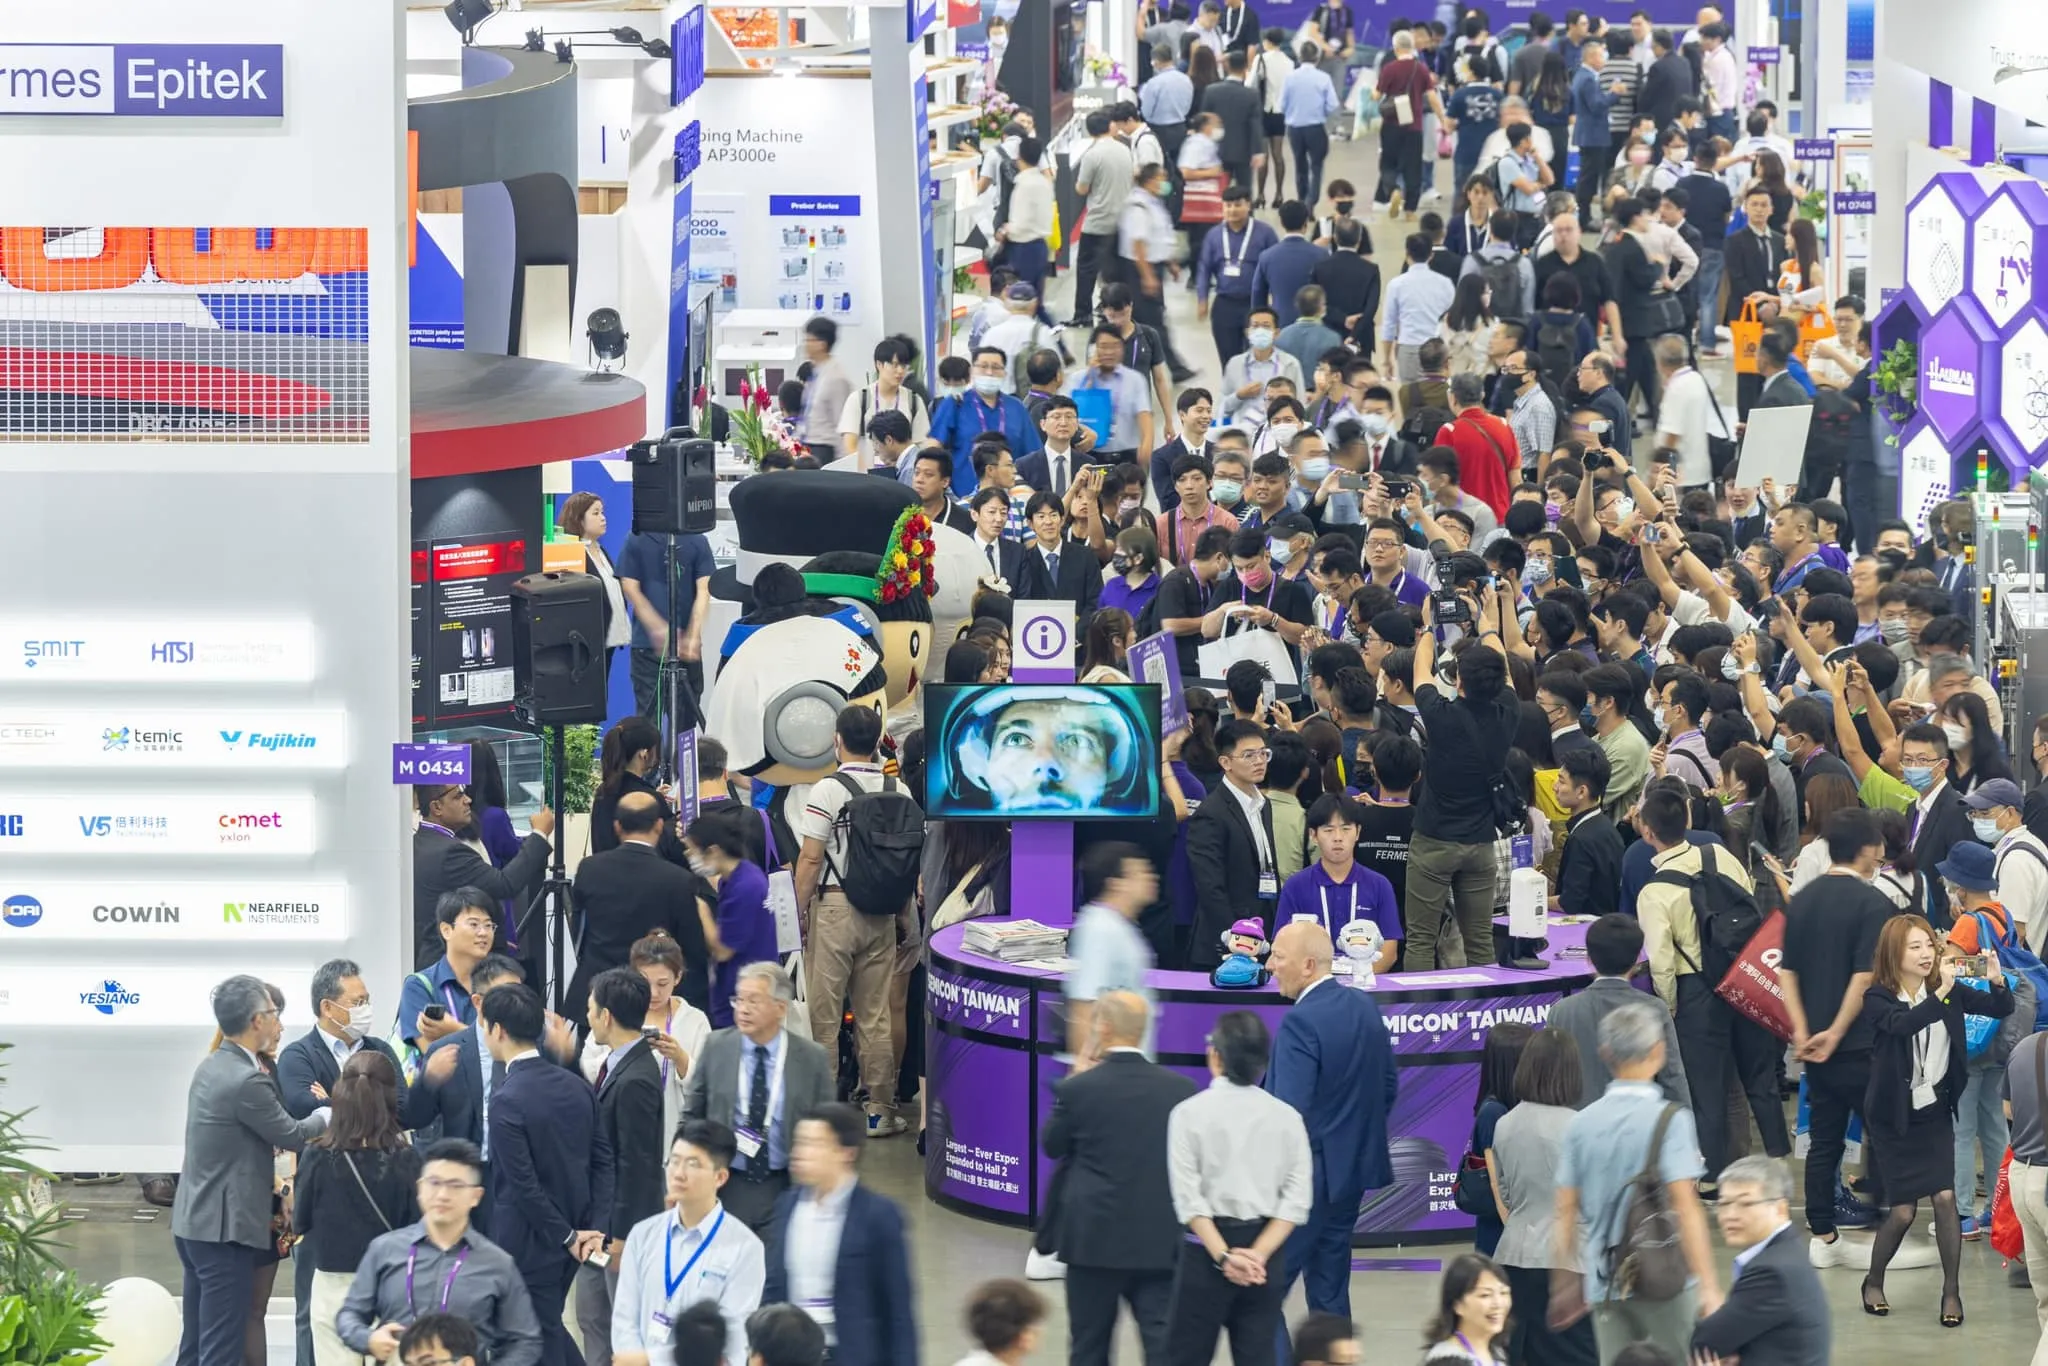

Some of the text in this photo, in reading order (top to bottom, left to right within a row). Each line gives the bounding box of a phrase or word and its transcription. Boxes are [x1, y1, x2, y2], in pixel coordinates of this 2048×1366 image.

[128, 59, 267, 108] Epitek
[737, 129, 803, 144] Machine
[707, 149, 776, 162] AP3000e
[817, 202, 839, 210] Series
[24, 640, 86, 657] SMIT
[151, 641, 194, 664] HTSI
[16, 728, 55, 738] TECH
[134, 728, 183, 744] temic
[247, 734, 316, 751] Fujikin
[400, 760, 465, 776] M 0434
[79, 816, 112, 837] V5
[220, 833, 251, 843] yxlon
[1376, 849, 1409, 861] FERME
[93, 904, 180, 923] COWIN
[249, 903, 319, 913] NEARFIELD
[248, 914, 320, 924] INSTRUMENTS
[79, 992, 140, 1005] YESIANG
[961, 987, 1019, 1017] TAIWAN
[1382, 1012, 1459, 1034] MICON
[945, 1137, 967, 1154] Largest
[975, 1147, 992, 1160] Ever
[995, 1151, 1019, 1165] Expo:
[945, 1151, 1008, 1177] Expanded to Hall 2
[1429, 1171, 1458, 1183] Larg
[1429, 1185, 1452, 1198] Exp
